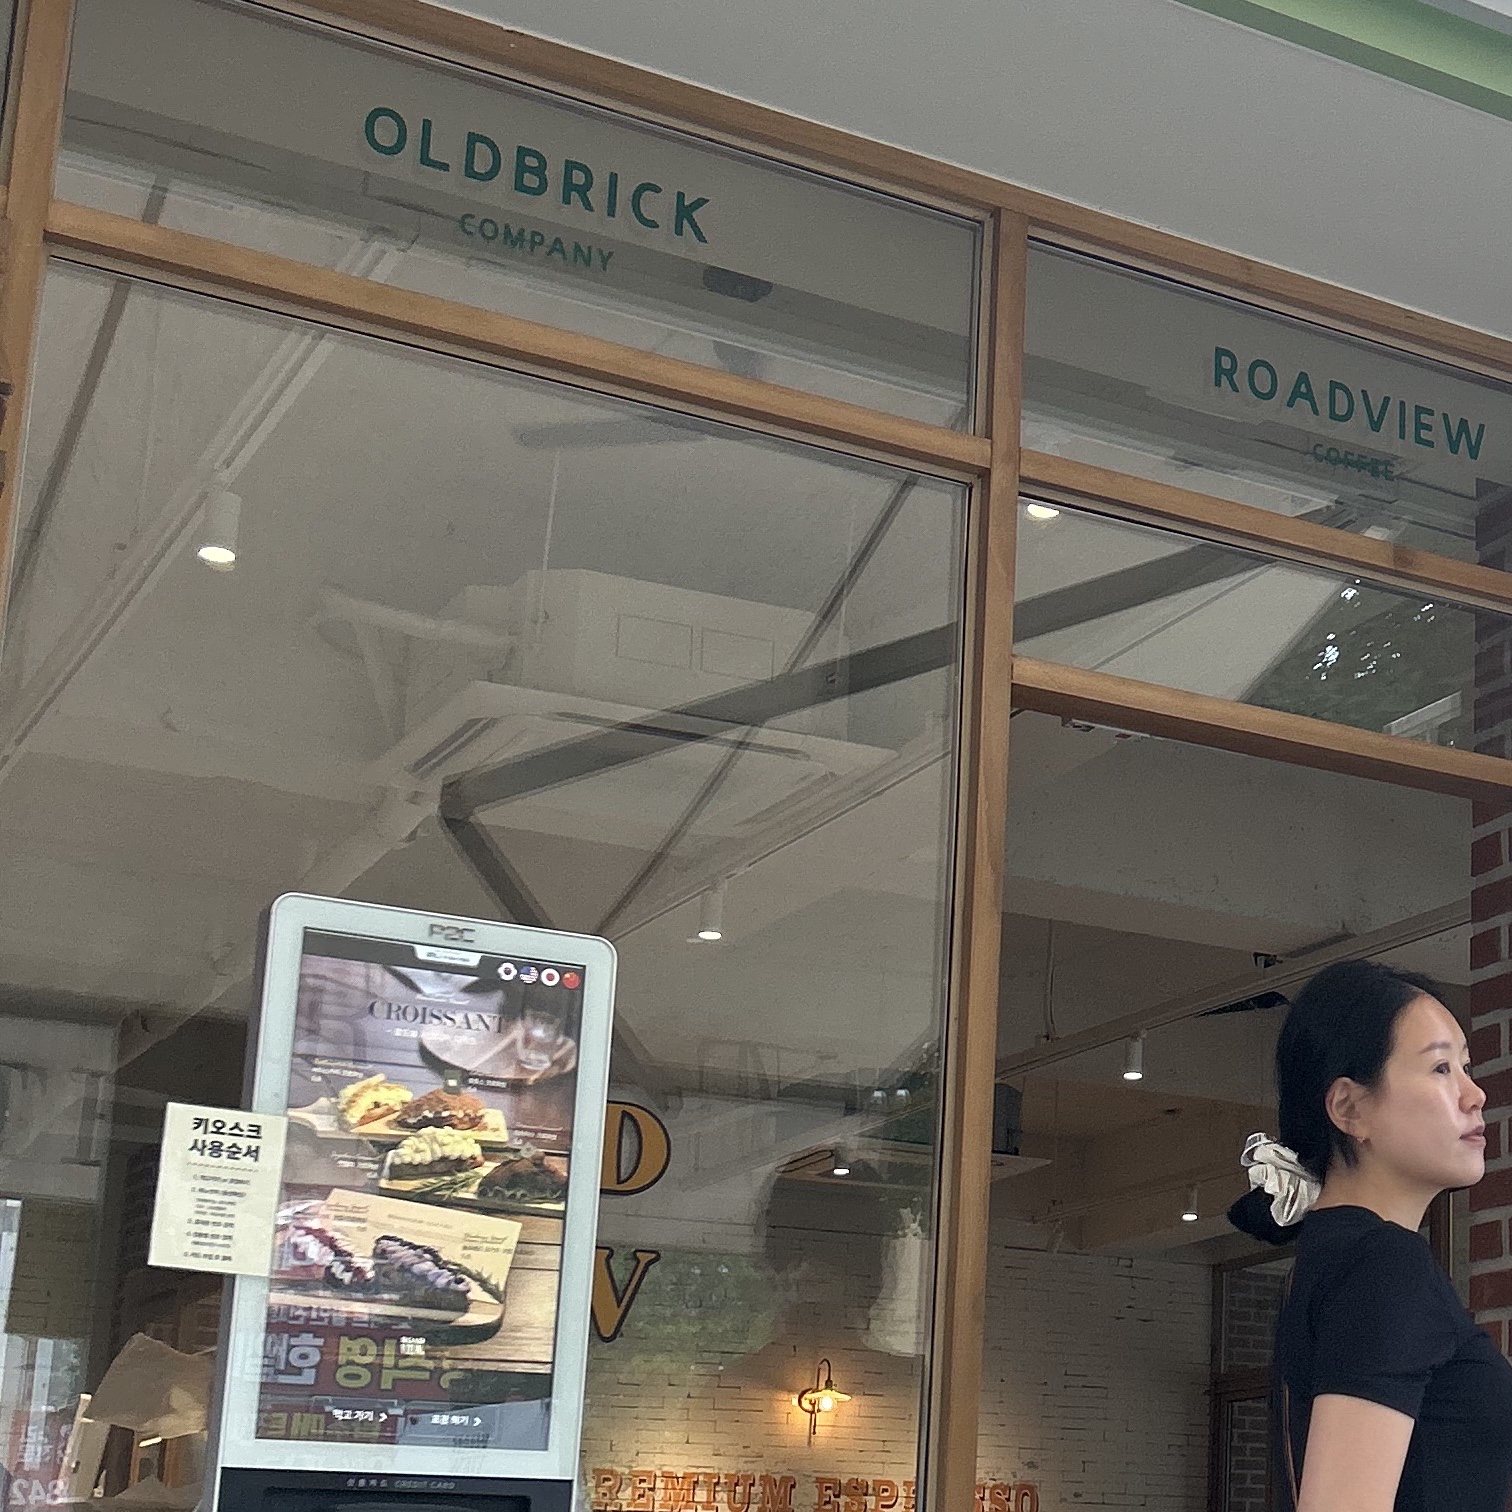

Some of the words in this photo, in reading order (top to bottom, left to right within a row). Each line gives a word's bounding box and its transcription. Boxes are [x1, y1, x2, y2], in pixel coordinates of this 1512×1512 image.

[364, 107, 709, 243] OLDBRICK
[458, 214, 615, 273] COMPANY
[1214, 346, 1485, 460] ROADVIEW
[1312, 443, 1396, 481] COFFEE
[367, 1000, 503, 1034] CROISSANT
[192, 1117, 262, 1140] 키오스크
[188, 1138, 260, 1162] 사용순서
